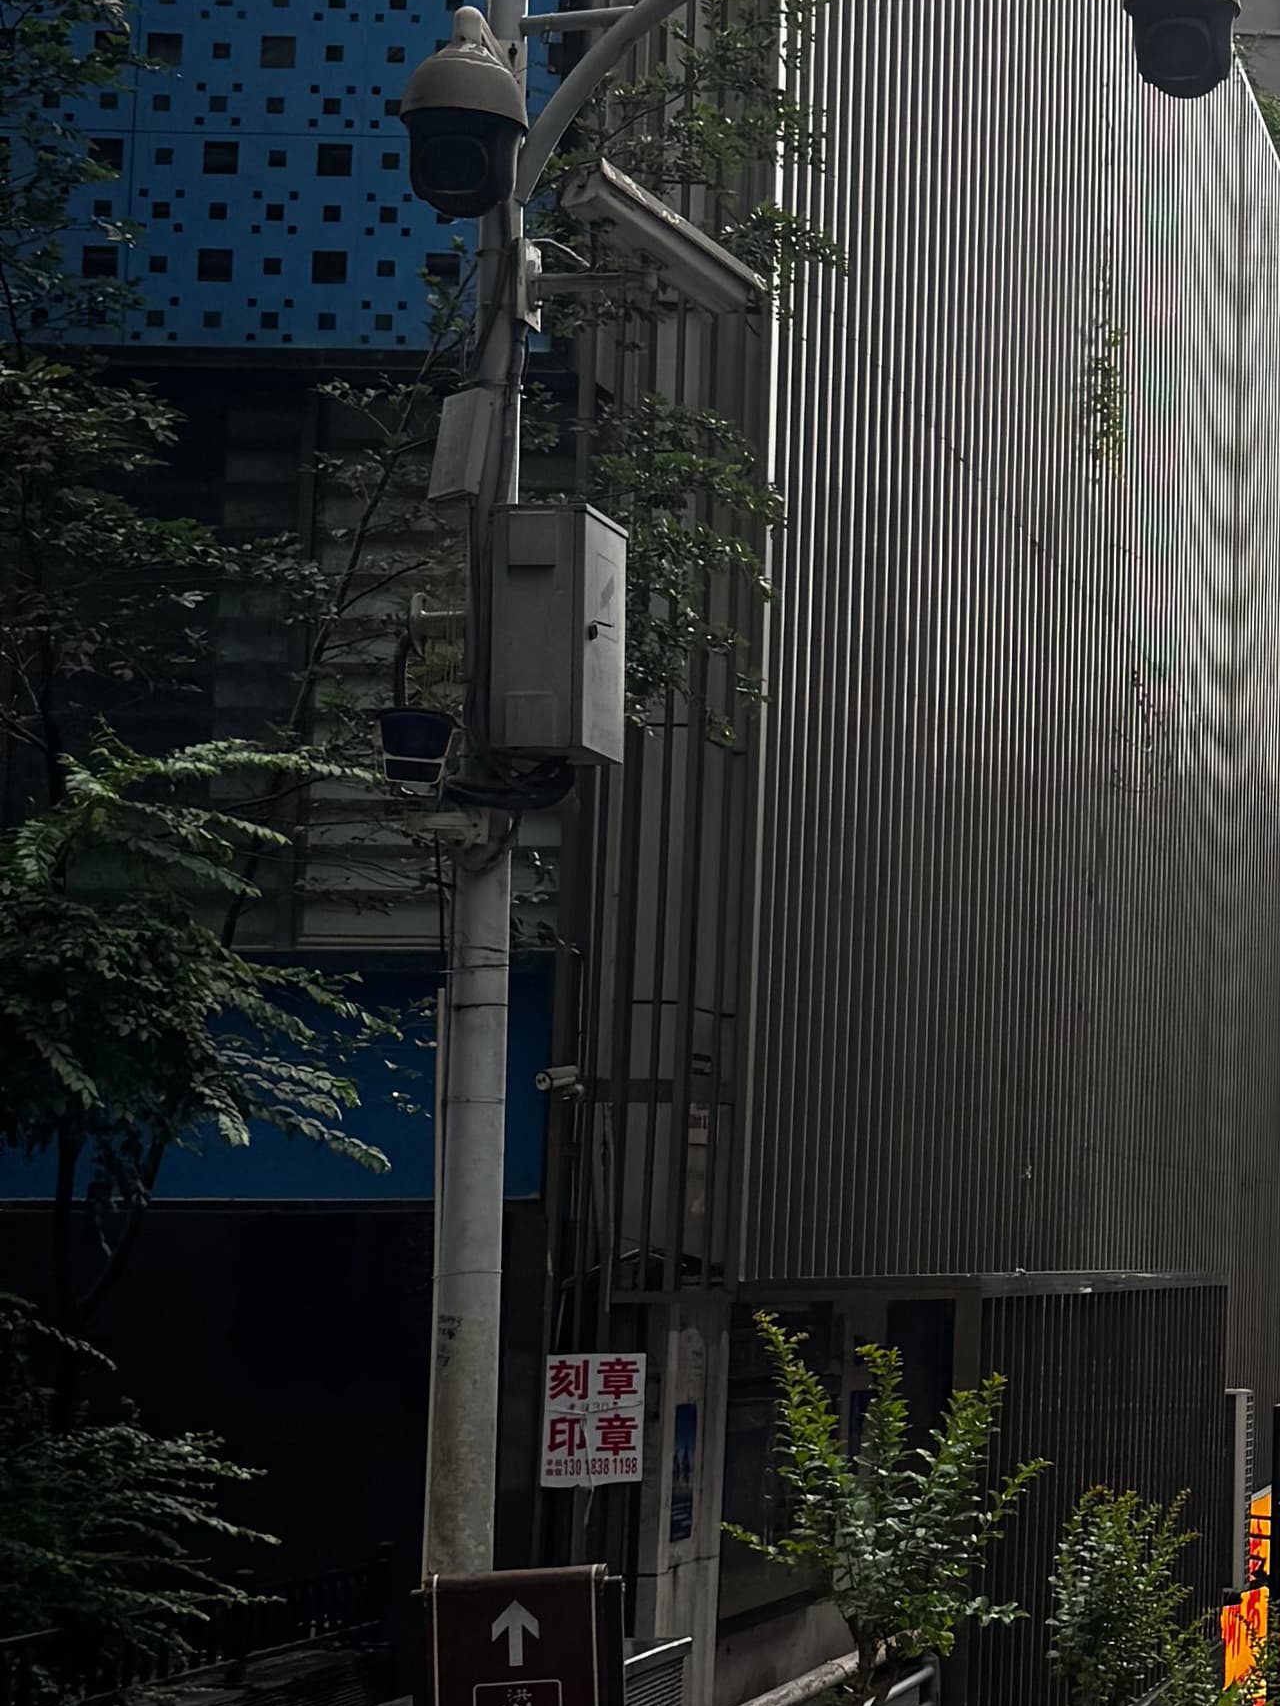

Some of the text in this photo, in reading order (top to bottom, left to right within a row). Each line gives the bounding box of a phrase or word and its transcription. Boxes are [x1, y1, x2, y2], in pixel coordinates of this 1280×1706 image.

[548, 1358, 640, 1400] 刻章
[547, 1413, 639, 1457] 印章
[563, 1459, 582, 1476] 130
[613, 1457, 638, 1475] 1198
